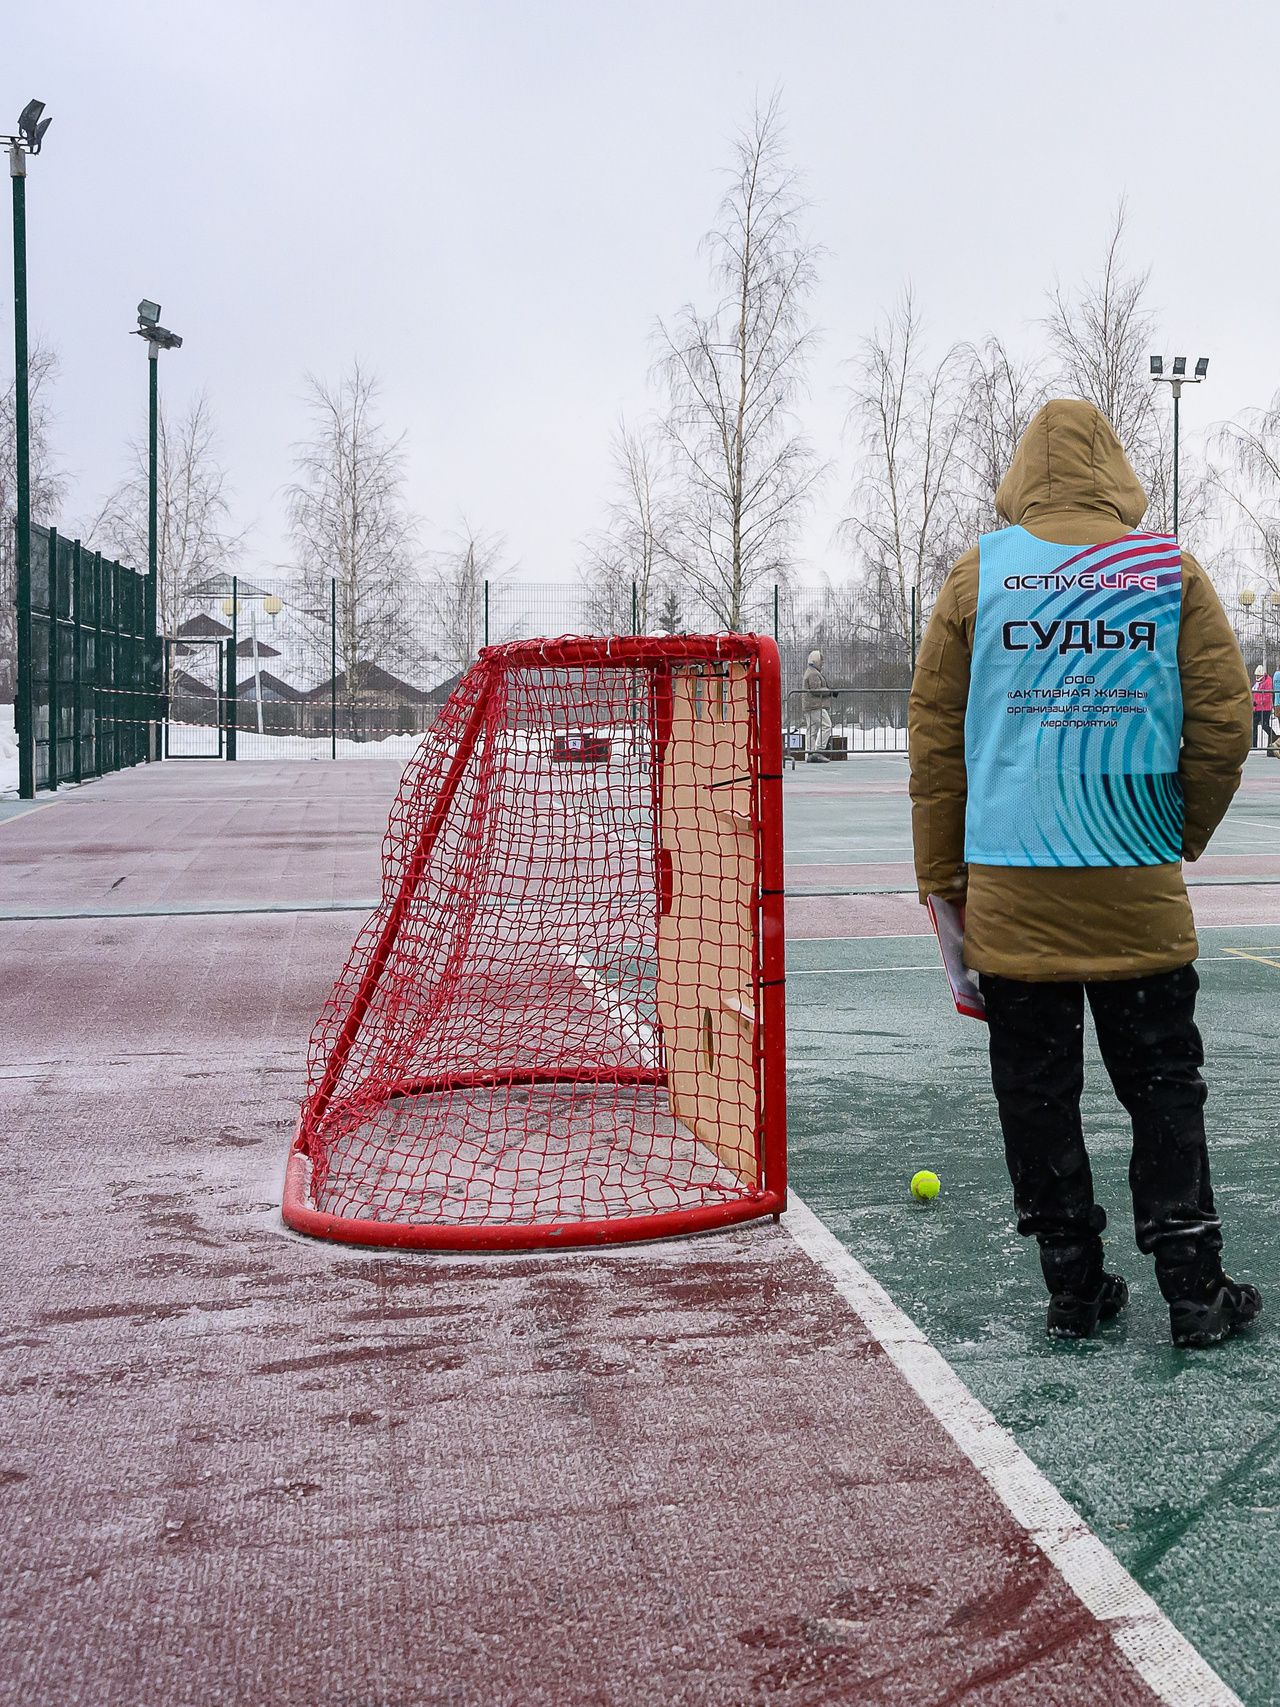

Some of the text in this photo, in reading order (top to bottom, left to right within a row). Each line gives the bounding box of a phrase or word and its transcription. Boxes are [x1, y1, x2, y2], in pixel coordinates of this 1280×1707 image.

[1003, 572, 1158, 591] ACTIVE LIFE
[1002, 620, 1157, 655] СУДЬЯ
[1007, 688, 1091, 699] «АКТИВНАЯ
[1006, 704, 1080, 716] организация
[1040, 718, 1118, 729] мероприятий
